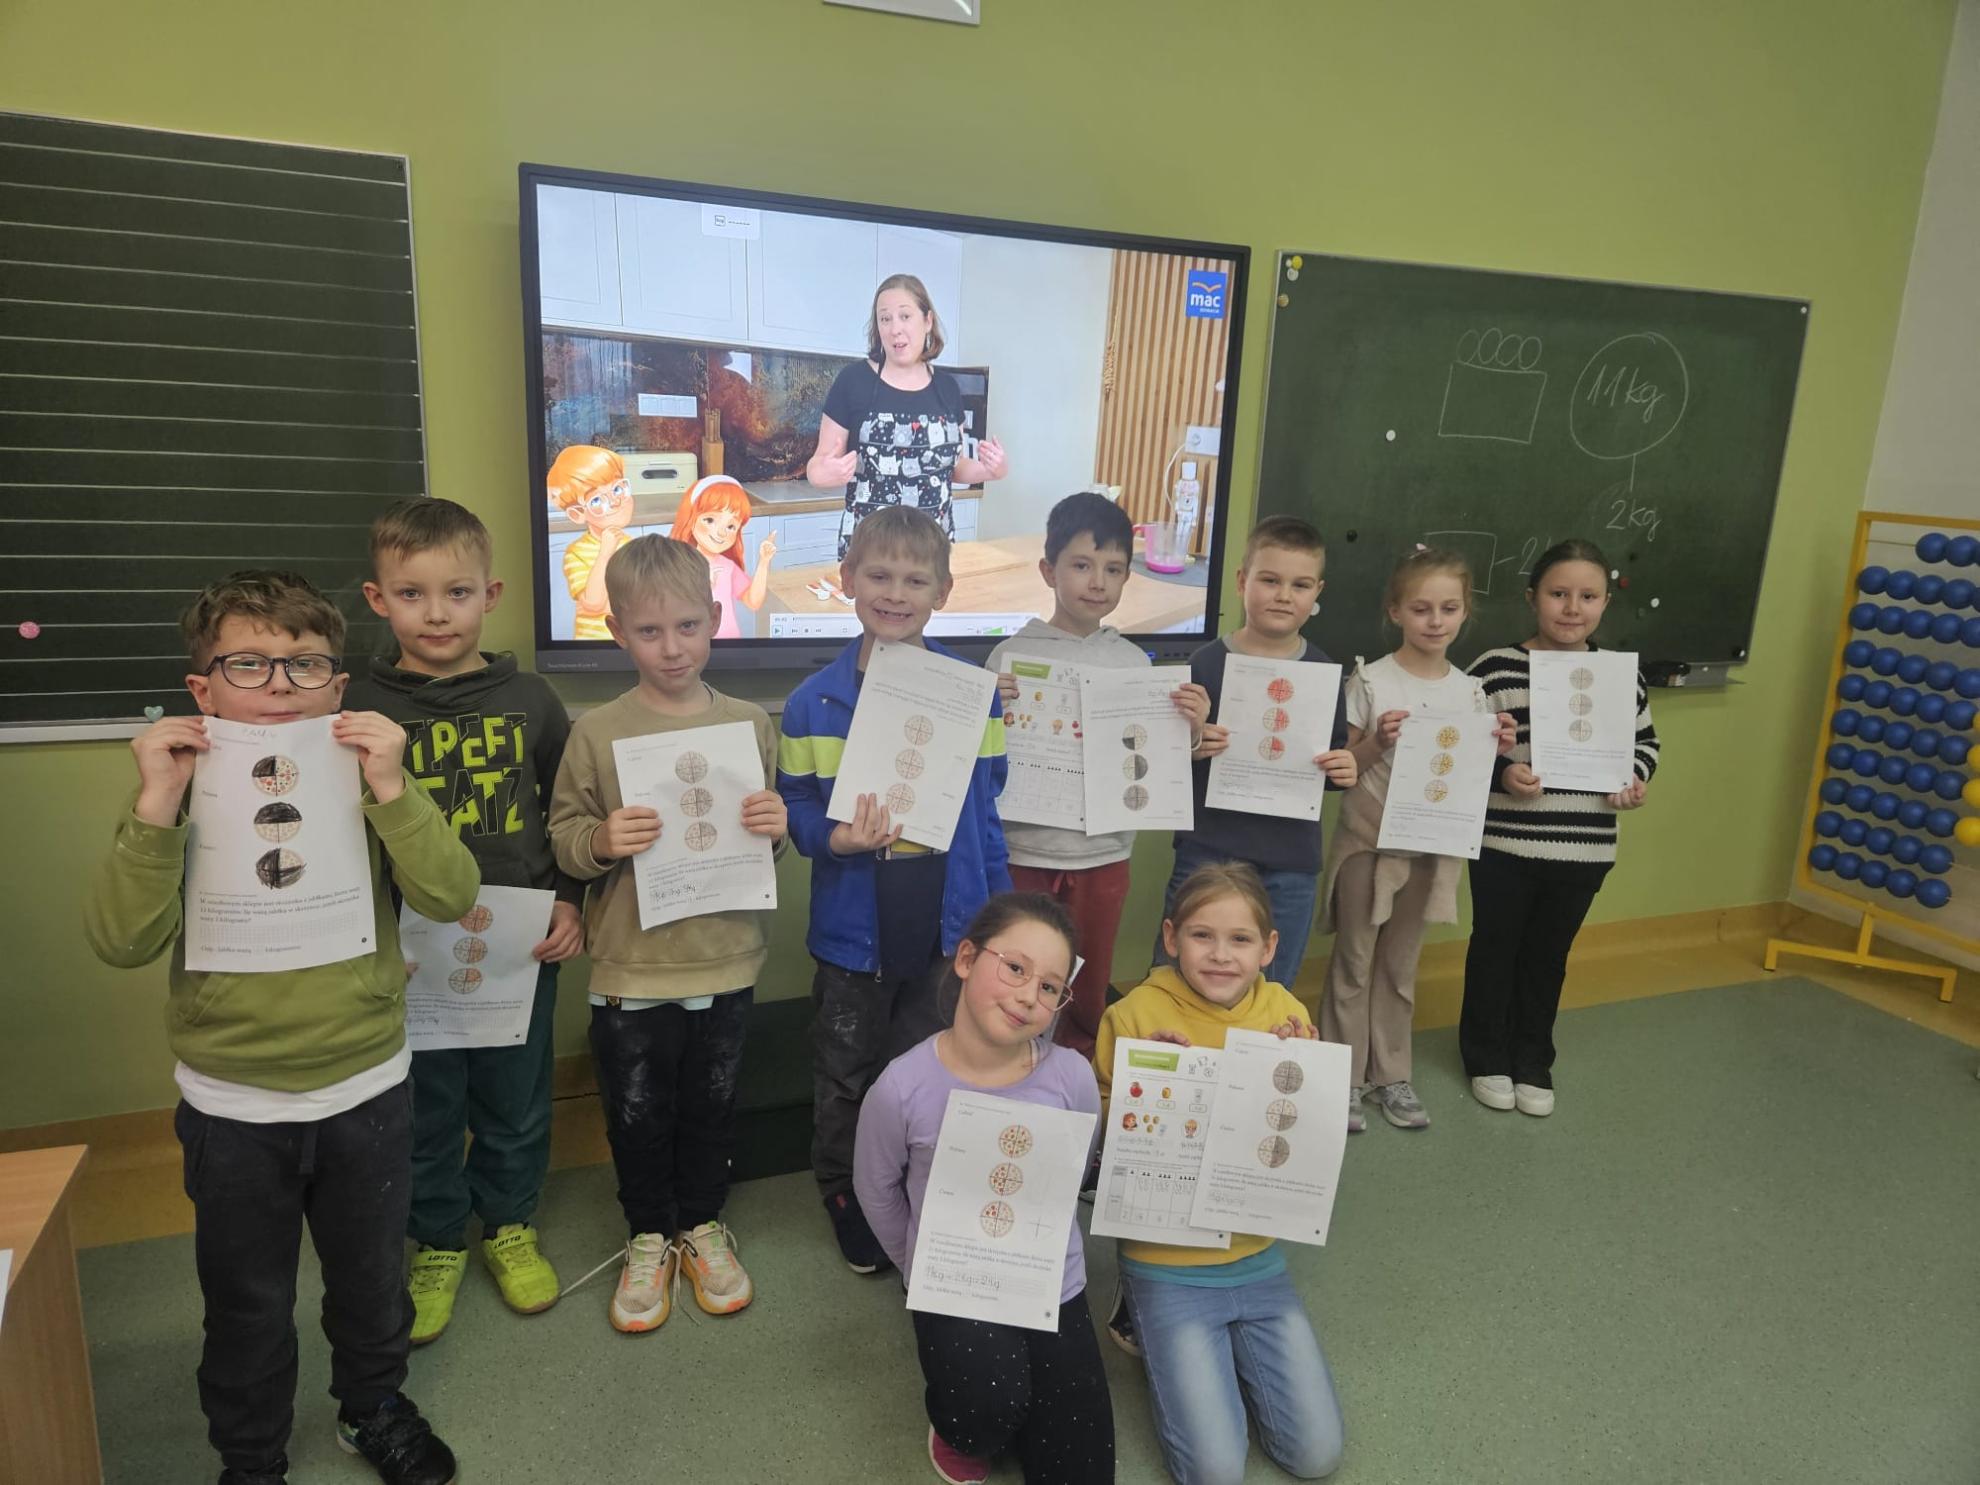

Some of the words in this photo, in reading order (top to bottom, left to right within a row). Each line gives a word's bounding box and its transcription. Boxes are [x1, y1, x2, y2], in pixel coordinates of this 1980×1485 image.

[1190, 294, 1221, 308] mac
[415, 767, 524, 837] ATZ
[494, 1235, 521, 1249] LOTTO
